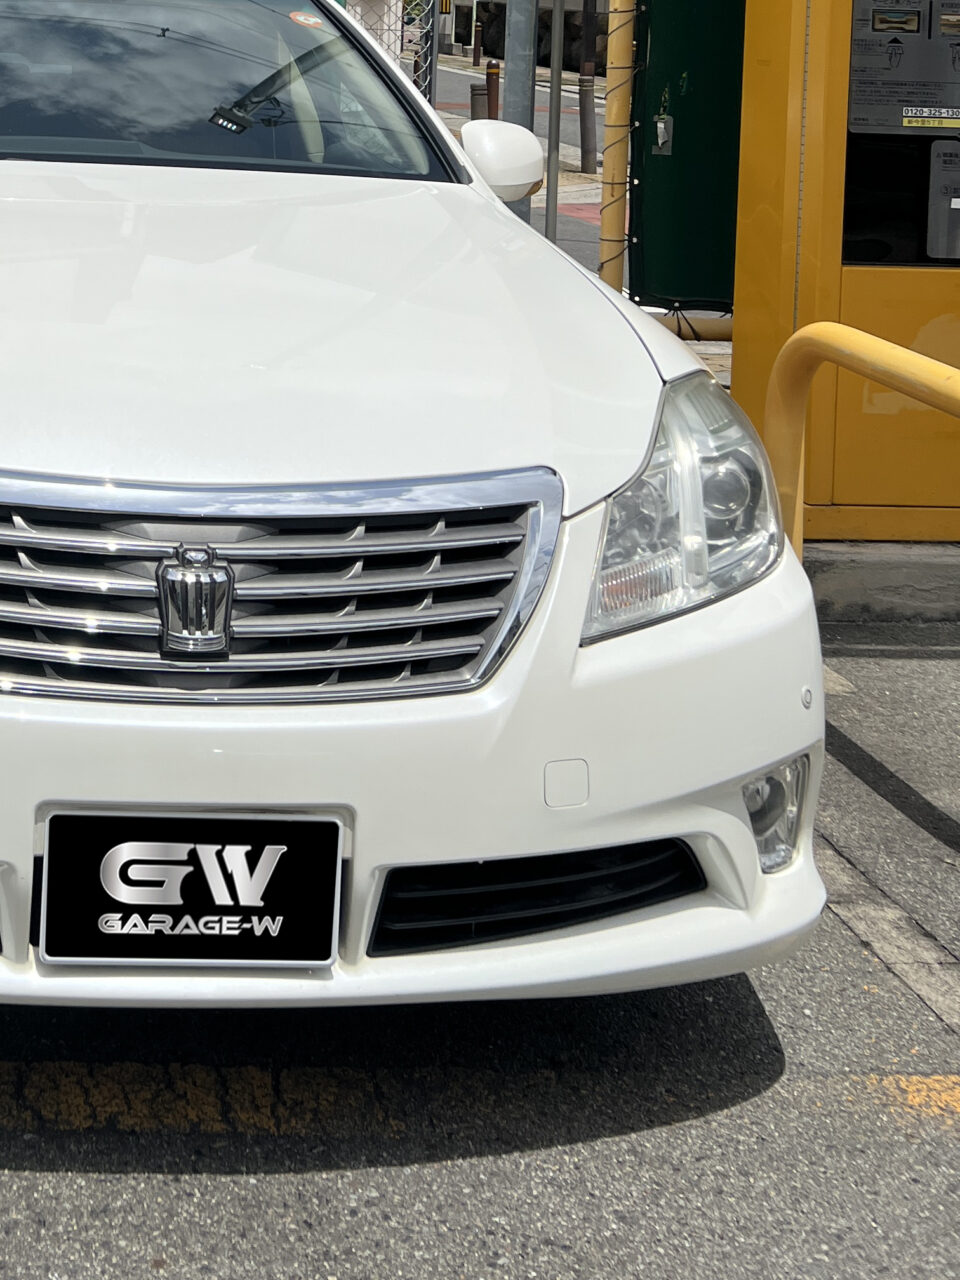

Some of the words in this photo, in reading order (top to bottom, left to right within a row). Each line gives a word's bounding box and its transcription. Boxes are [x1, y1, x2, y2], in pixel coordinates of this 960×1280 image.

[904, 108, 960, 117] 0120-325-130
[99, 841, 288, 907] GW
[98, 913, 284, 937] GARAGE-W
